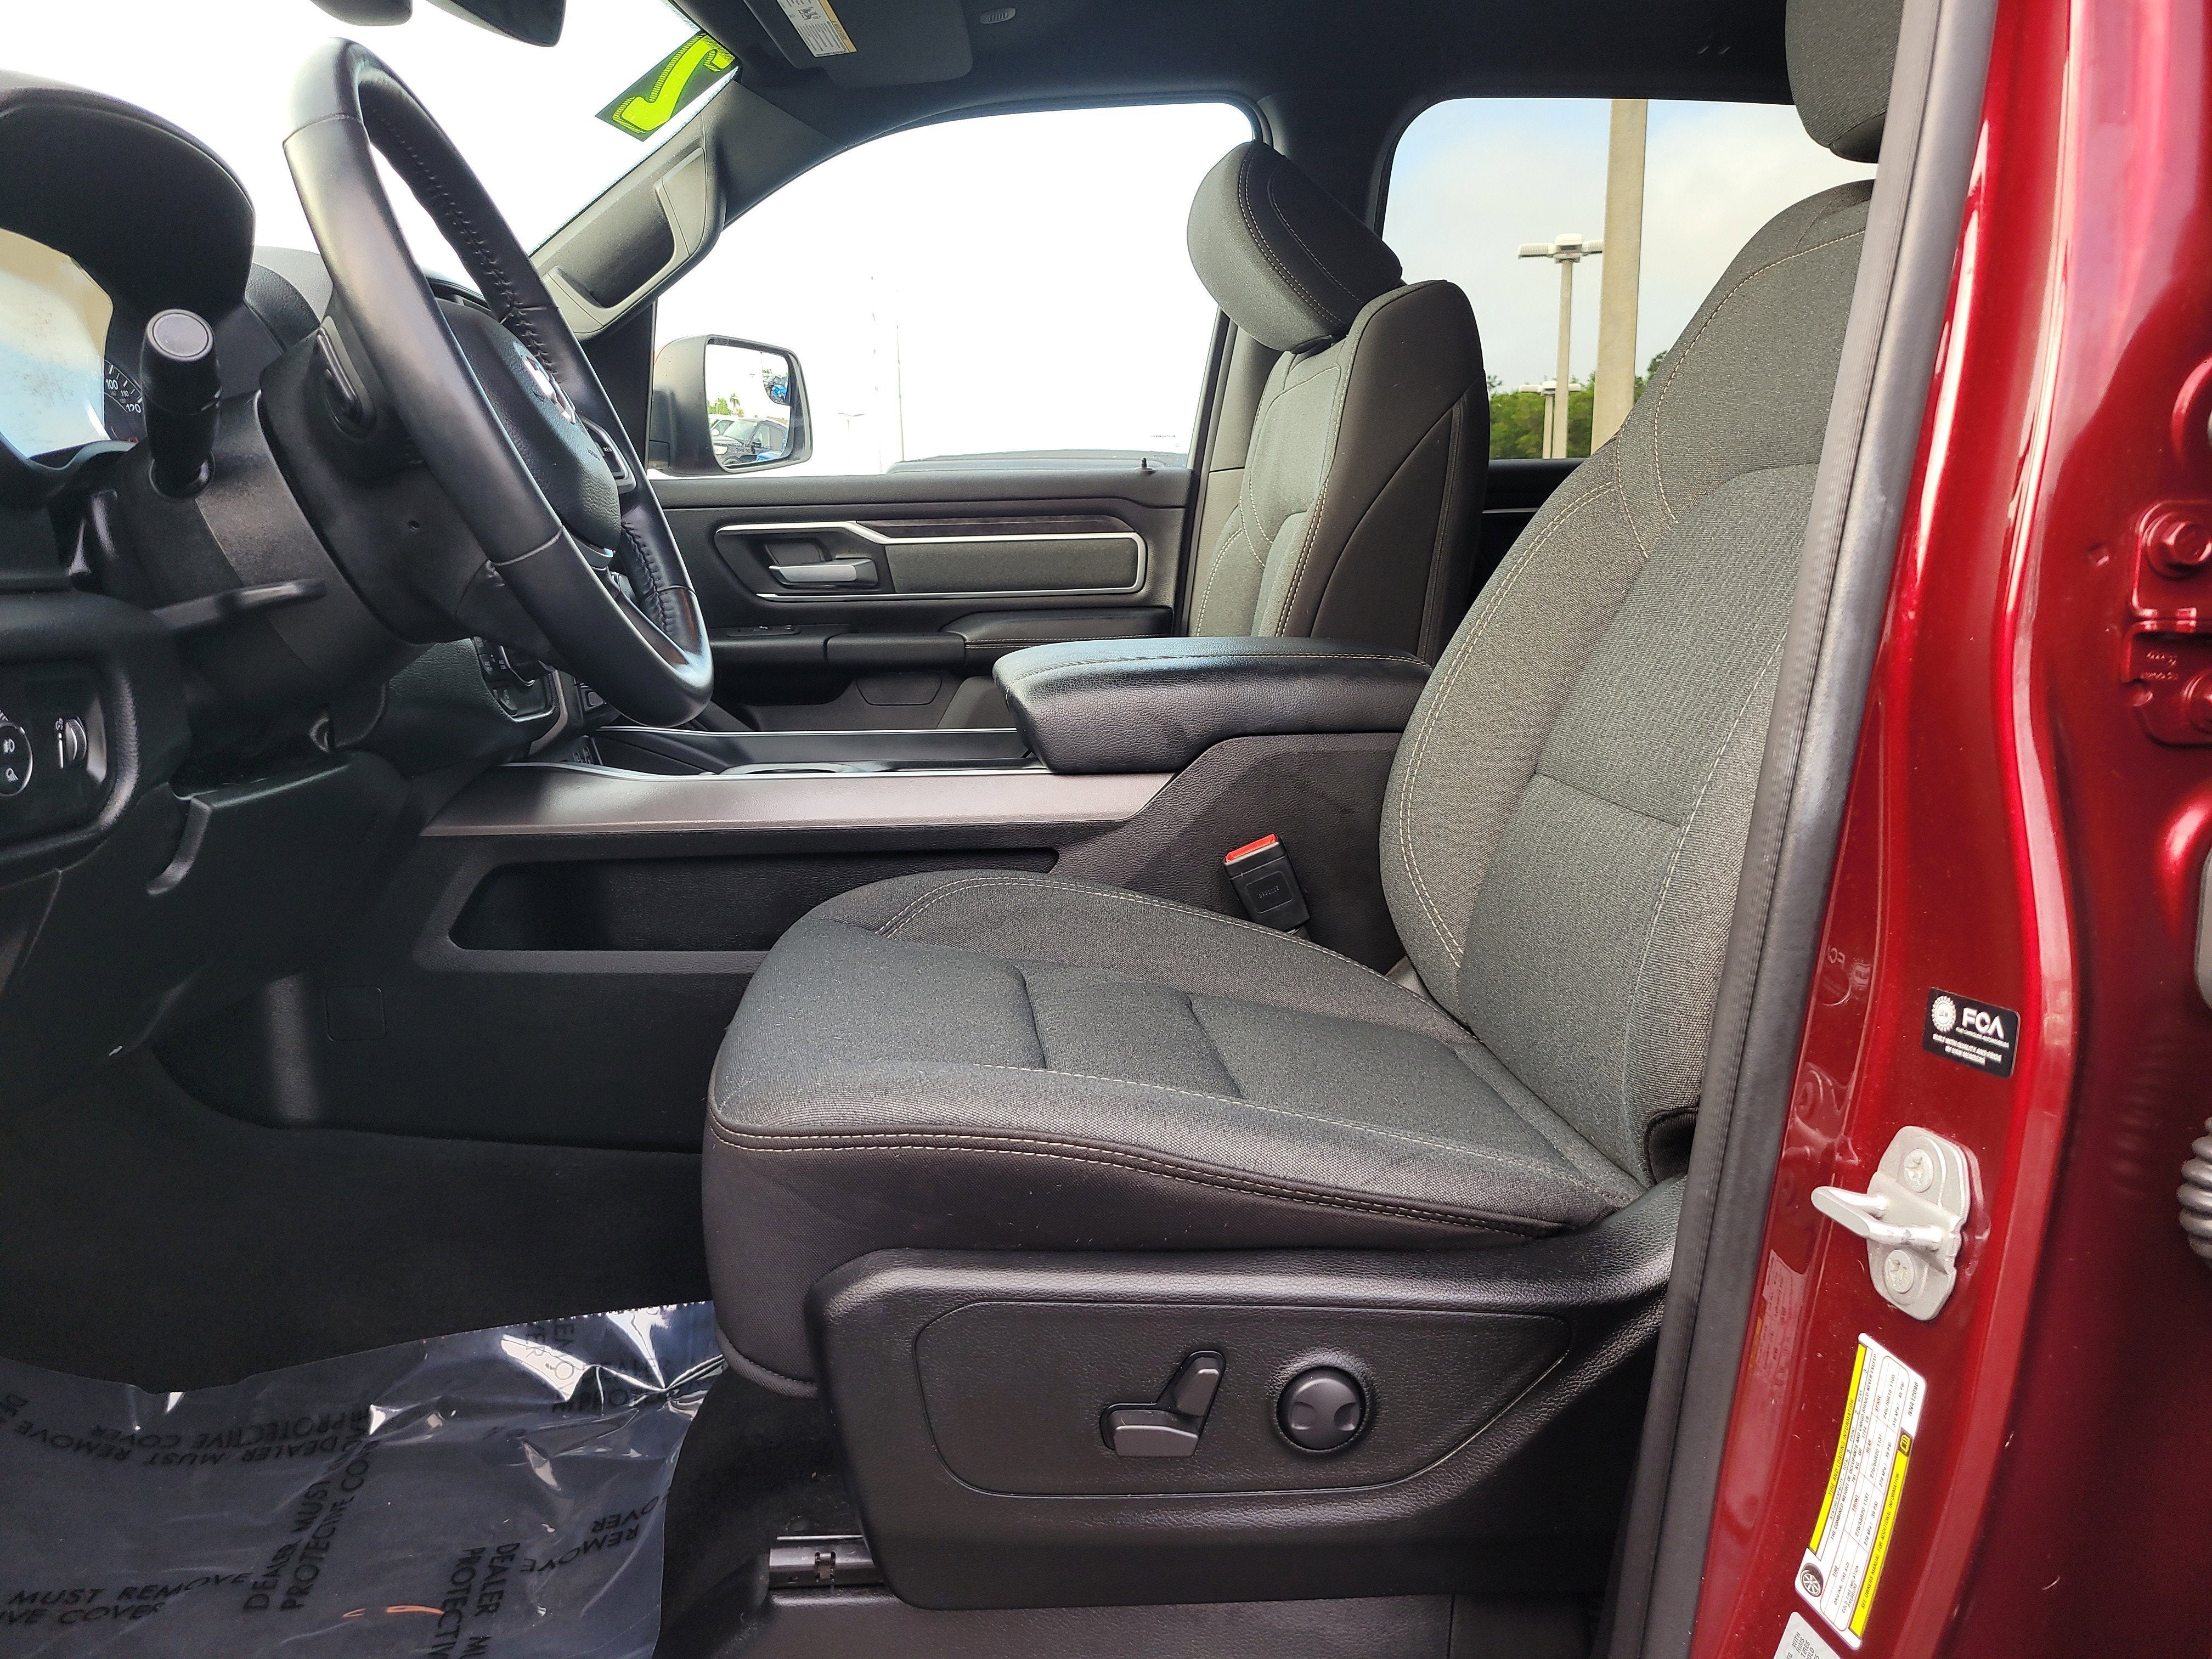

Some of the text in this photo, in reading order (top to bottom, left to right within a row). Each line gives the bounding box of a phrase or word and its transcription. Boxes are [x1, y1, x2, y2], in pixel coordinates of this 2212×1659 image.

[105, 379, 119, 390] 100
[1962, 1007, 2004, 1039] FCA
[1908, 1381, 1918, 1417] NN412098
[14, 1419, 132, 1462] REMOVE
[191, 1411, 346, 1449] PROTECTIVE
[1836, 1441, 1846, 1468] LOADING
[1842, 1398, 1854, 1440] INFORMATION
[142, 1451, 225, 1466] MUST
[241, 1435, 338, 1463] DEALER
[1834, 1503, 1843, 1530] COMBINED
[1849, 1444, 1858, 1474] OCCUPANTS
[592, 1496, 660, 1533] OVER
[520, 1523, 640, 1573] REMOVE
[1865, 1576, 1873, 1598] OWNERS
[1871, 1554, 1880, 1575] MANUAL
[1881, 1510, 1891, 1541] ADDITIONAL
[1888, 1472, 1899, 1509] INFORMATION
[8, 1571, 254, 1605] MUST REMOVE
[474, 1542, 521, 1617] DEALER
[1849, 1566, 1859, 1589] INFLATION
[427, 1547, 487, 1659] PROTECTIV
[1834, 1585, 1843, 1605] ORIGINAL
[1847, 1583, 1858, 1608] PRESSURE
[1792, 1632, 1801, 1647] WITH
[1796, 1637, 1805, 1653] RIMS
[1801, 1640, 1810, 1657] TIRES
